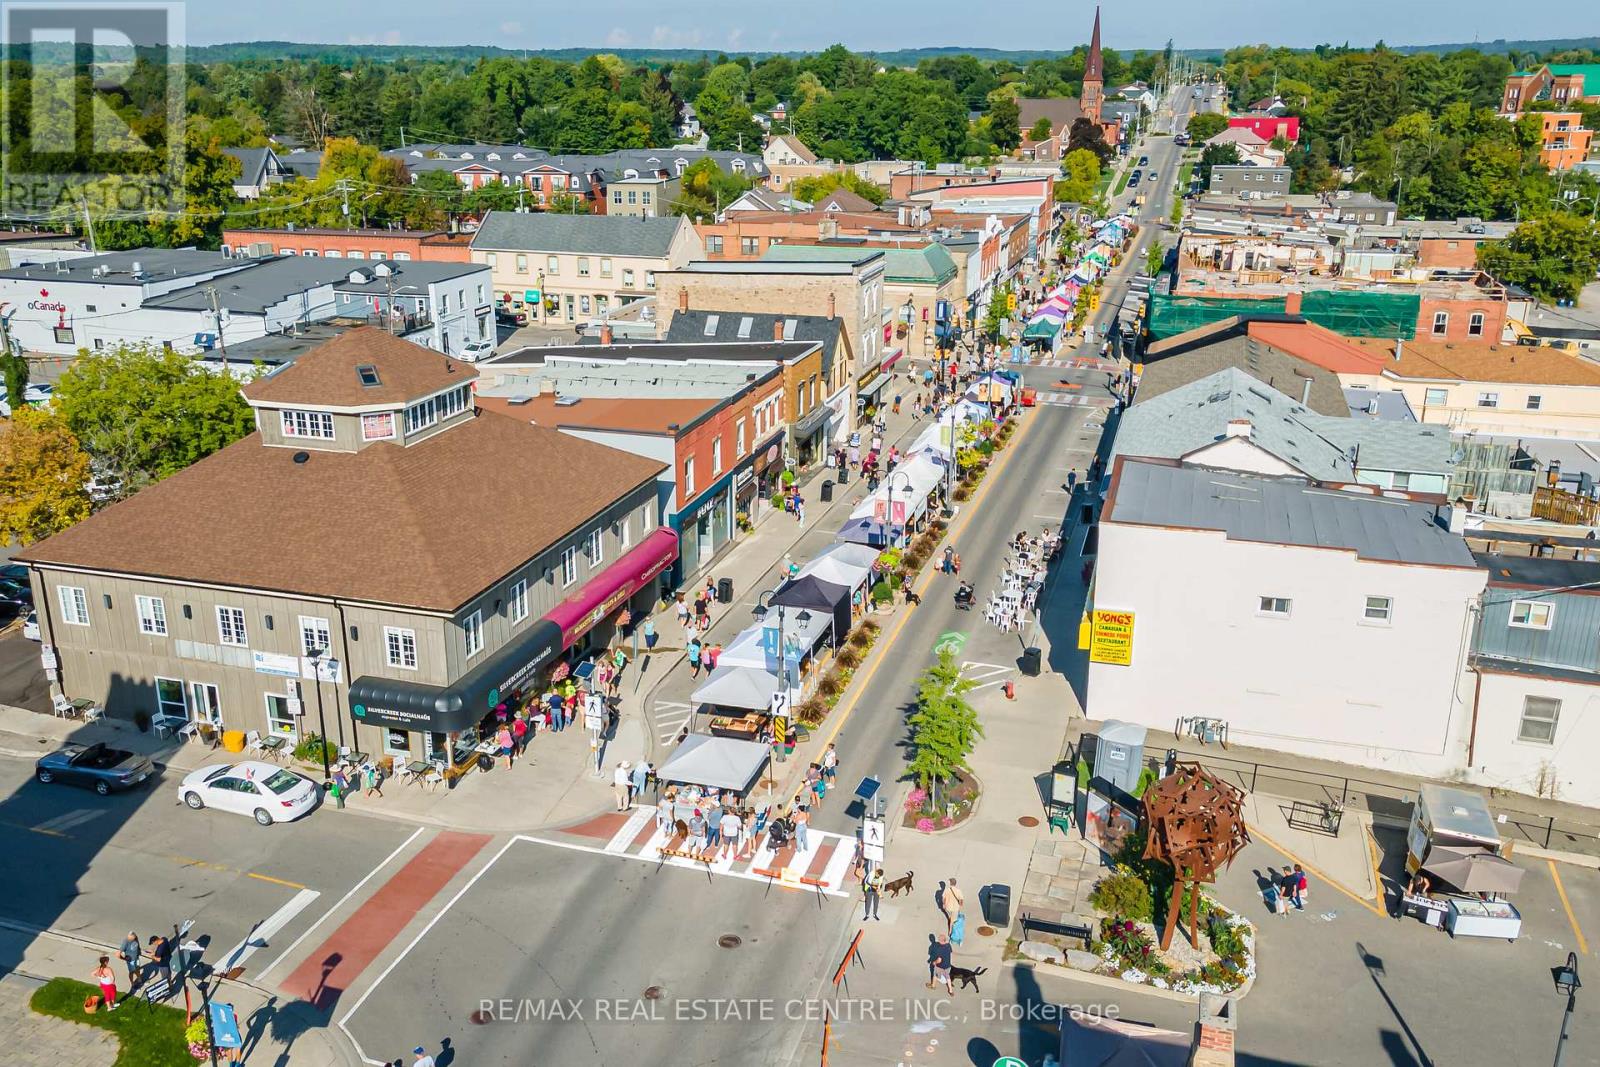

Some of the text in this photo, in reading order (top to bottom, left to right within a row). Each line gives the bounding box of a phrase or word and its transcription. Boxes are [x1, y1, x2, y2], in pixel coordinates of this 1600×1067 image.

[1097, 612, 1132, 625] YONG'S
[499, 664, 527, 692] SILVERCREEK
[367, 706, 398, 716] SILVERCREEK
